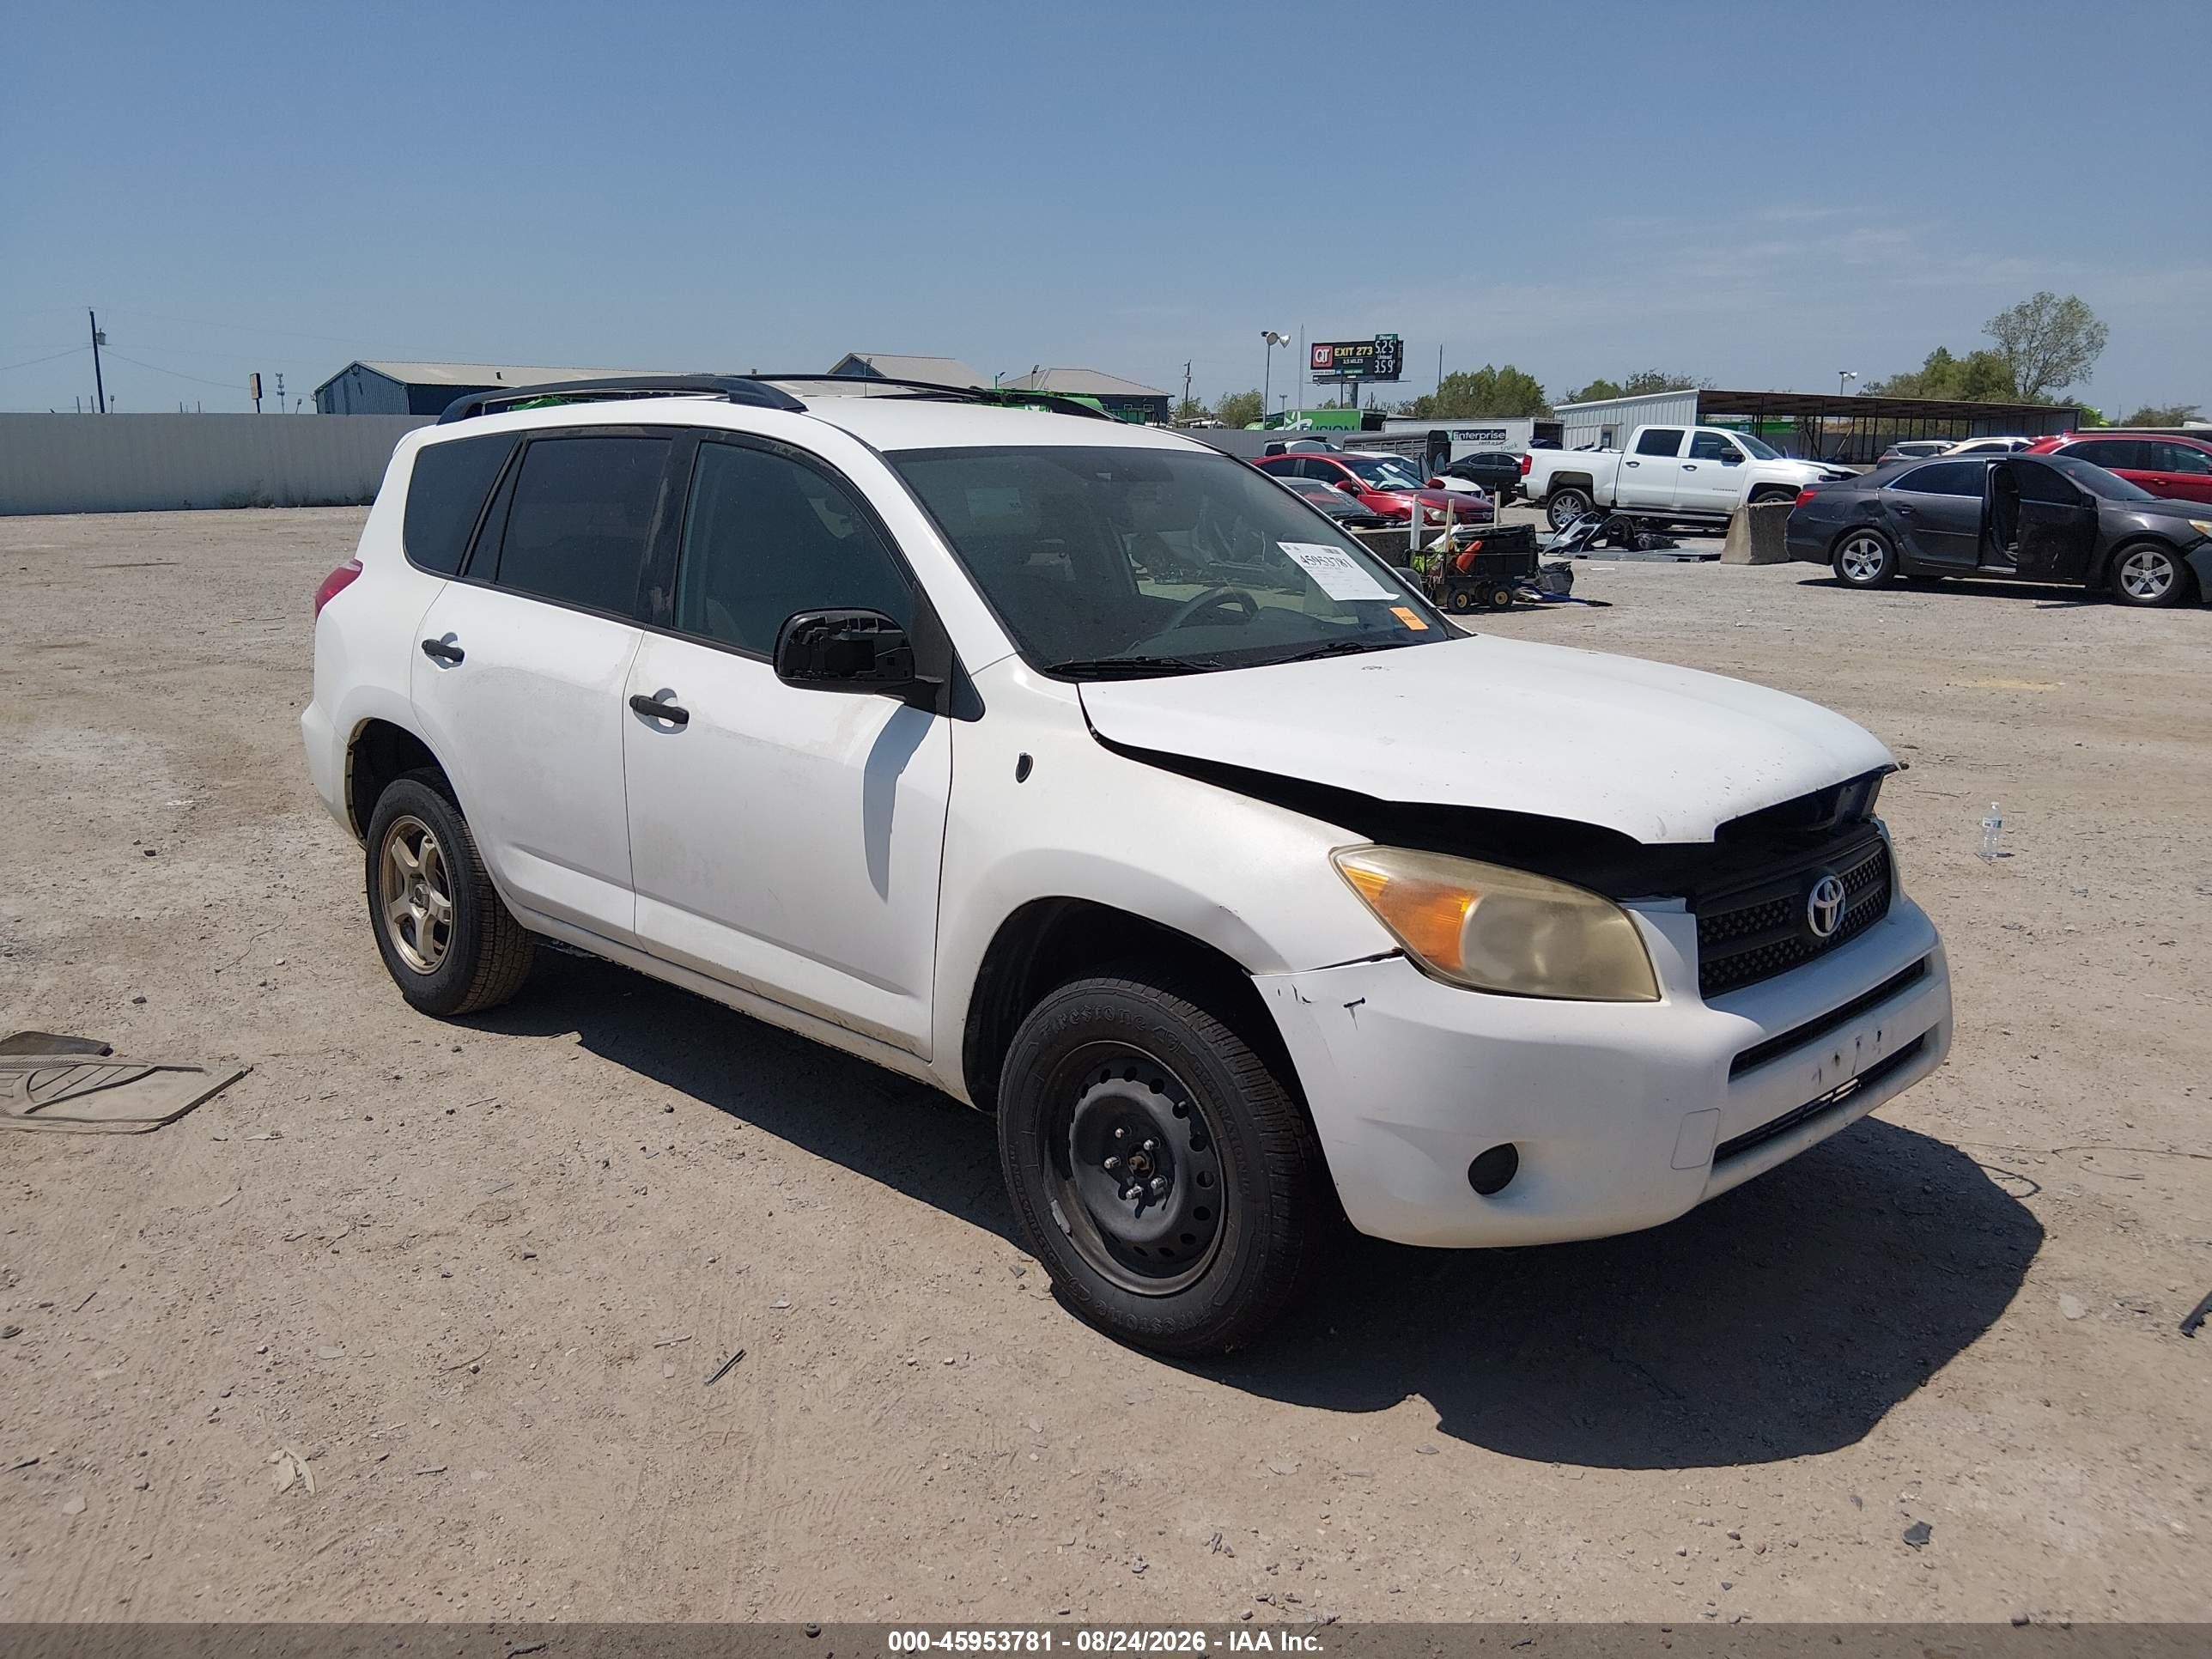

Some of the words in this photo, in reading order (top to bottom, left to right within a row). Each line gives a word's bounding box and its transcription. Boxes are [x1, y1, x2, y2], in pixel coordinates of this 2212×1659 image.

[1315, 349, 1330, 364] QT
[1334, 347, 1354, 357] EXIT
[1356, 346, 1373, 356] 273
[1453, 430, 1505, 441] Enterprise
[1299, 555, 1353, 568] 45953781
[1038, 1004, 1147, 1036] Firestone
